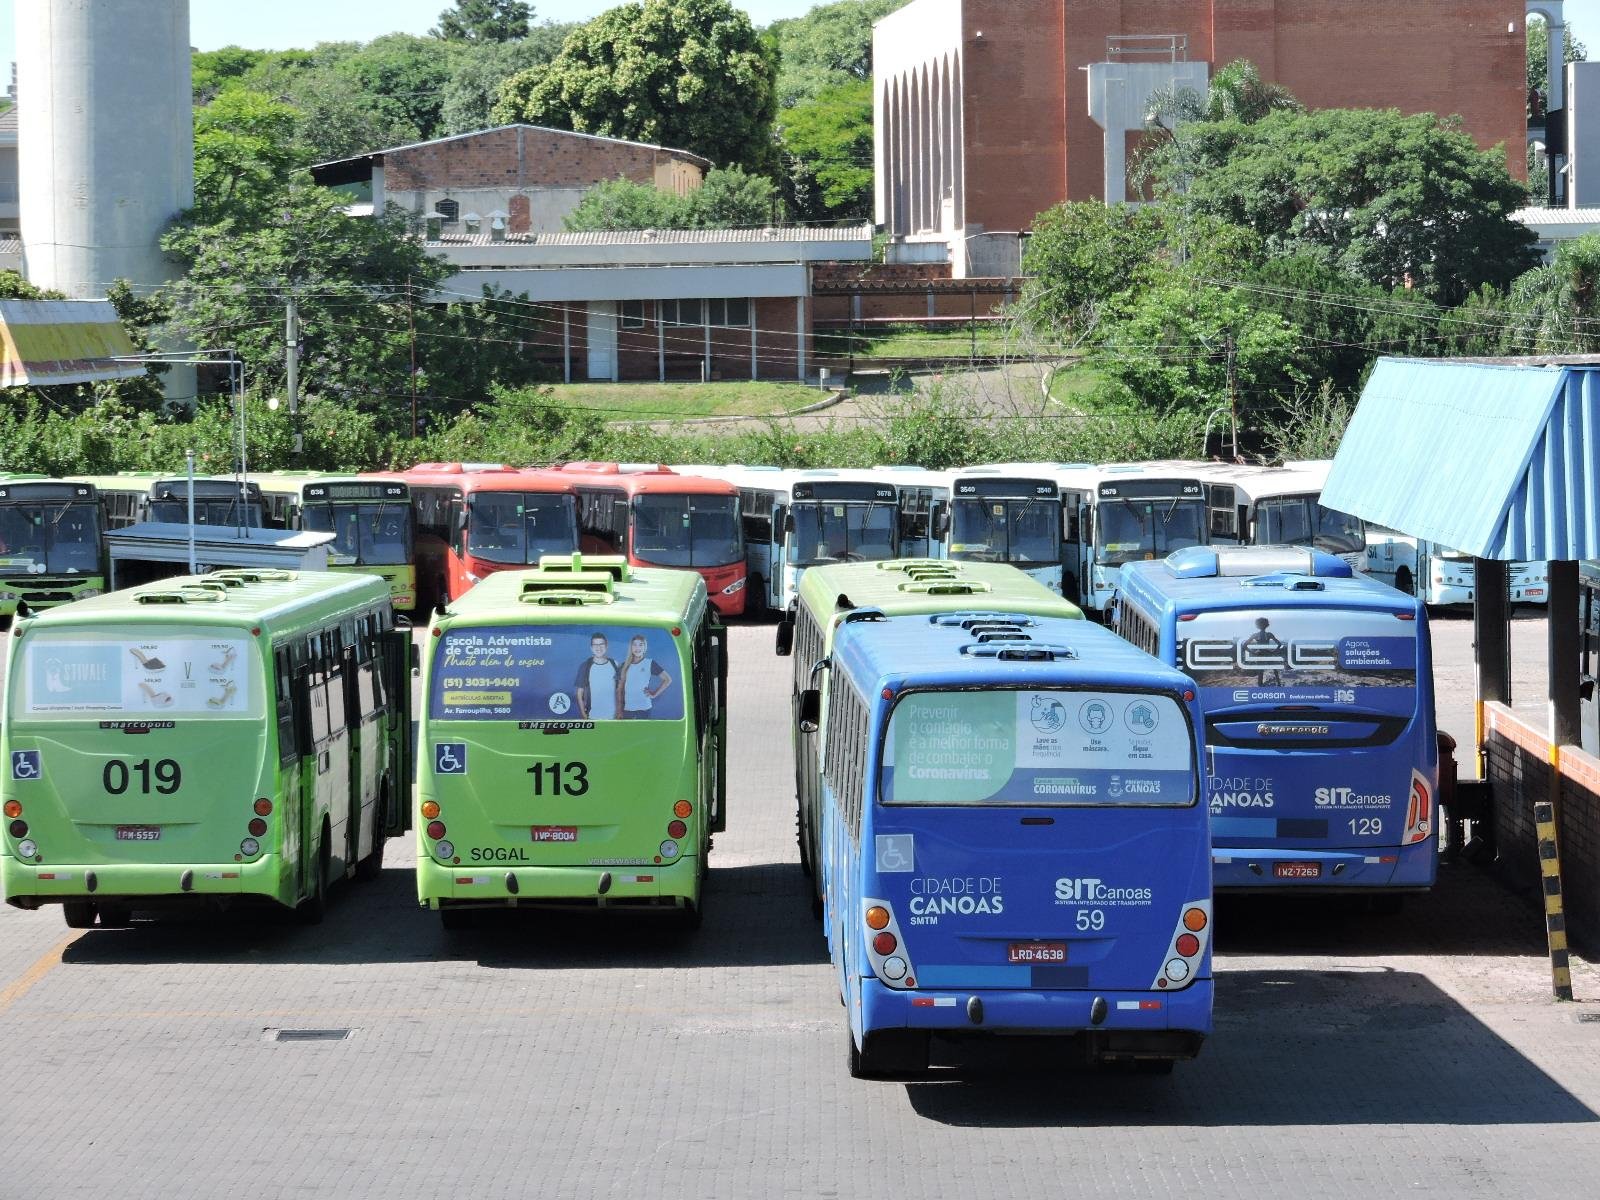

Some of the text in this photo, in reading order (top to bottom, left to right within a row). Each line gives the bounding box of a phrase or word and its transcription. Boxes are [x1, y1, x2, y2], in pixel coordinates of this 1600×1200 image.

[445, 635, 552, 646] Escola Adventista
[445, 645, 509, 655] de Canoas
[1345, 648, 1380, 657] soluções
[444, 655, 476, 667] Muito
[1345, 657, 1392, 665] ambientais.
[444, 677, 463, 688] (51)
[910, 704, 960, 719] Prevenir
[111, 721, 173, 729] Marcopolo
[530, 722, 593, 730] Marcopolo
[103, 758, 182, 795] 019
[527, 761, 589, 796] 113
[1034, 783, 1096, 795] CORONAVÍRUS
[1125, 784, 1161, 793] CANOAS
[1209, 777, 1273, 791] IDADE DE
[1208, 792, 1274, 808] ANOAS
[1347, 817, 1382, 836] 129
[470, 847, 530, 861] SOGAL
[910, 877, 1002, 895] CIDADE DE
[909, 896, 1004, 915] CANOAS
[910, 916, 938, 925] SMTM
[1076, 909, 1105, 931] 59
